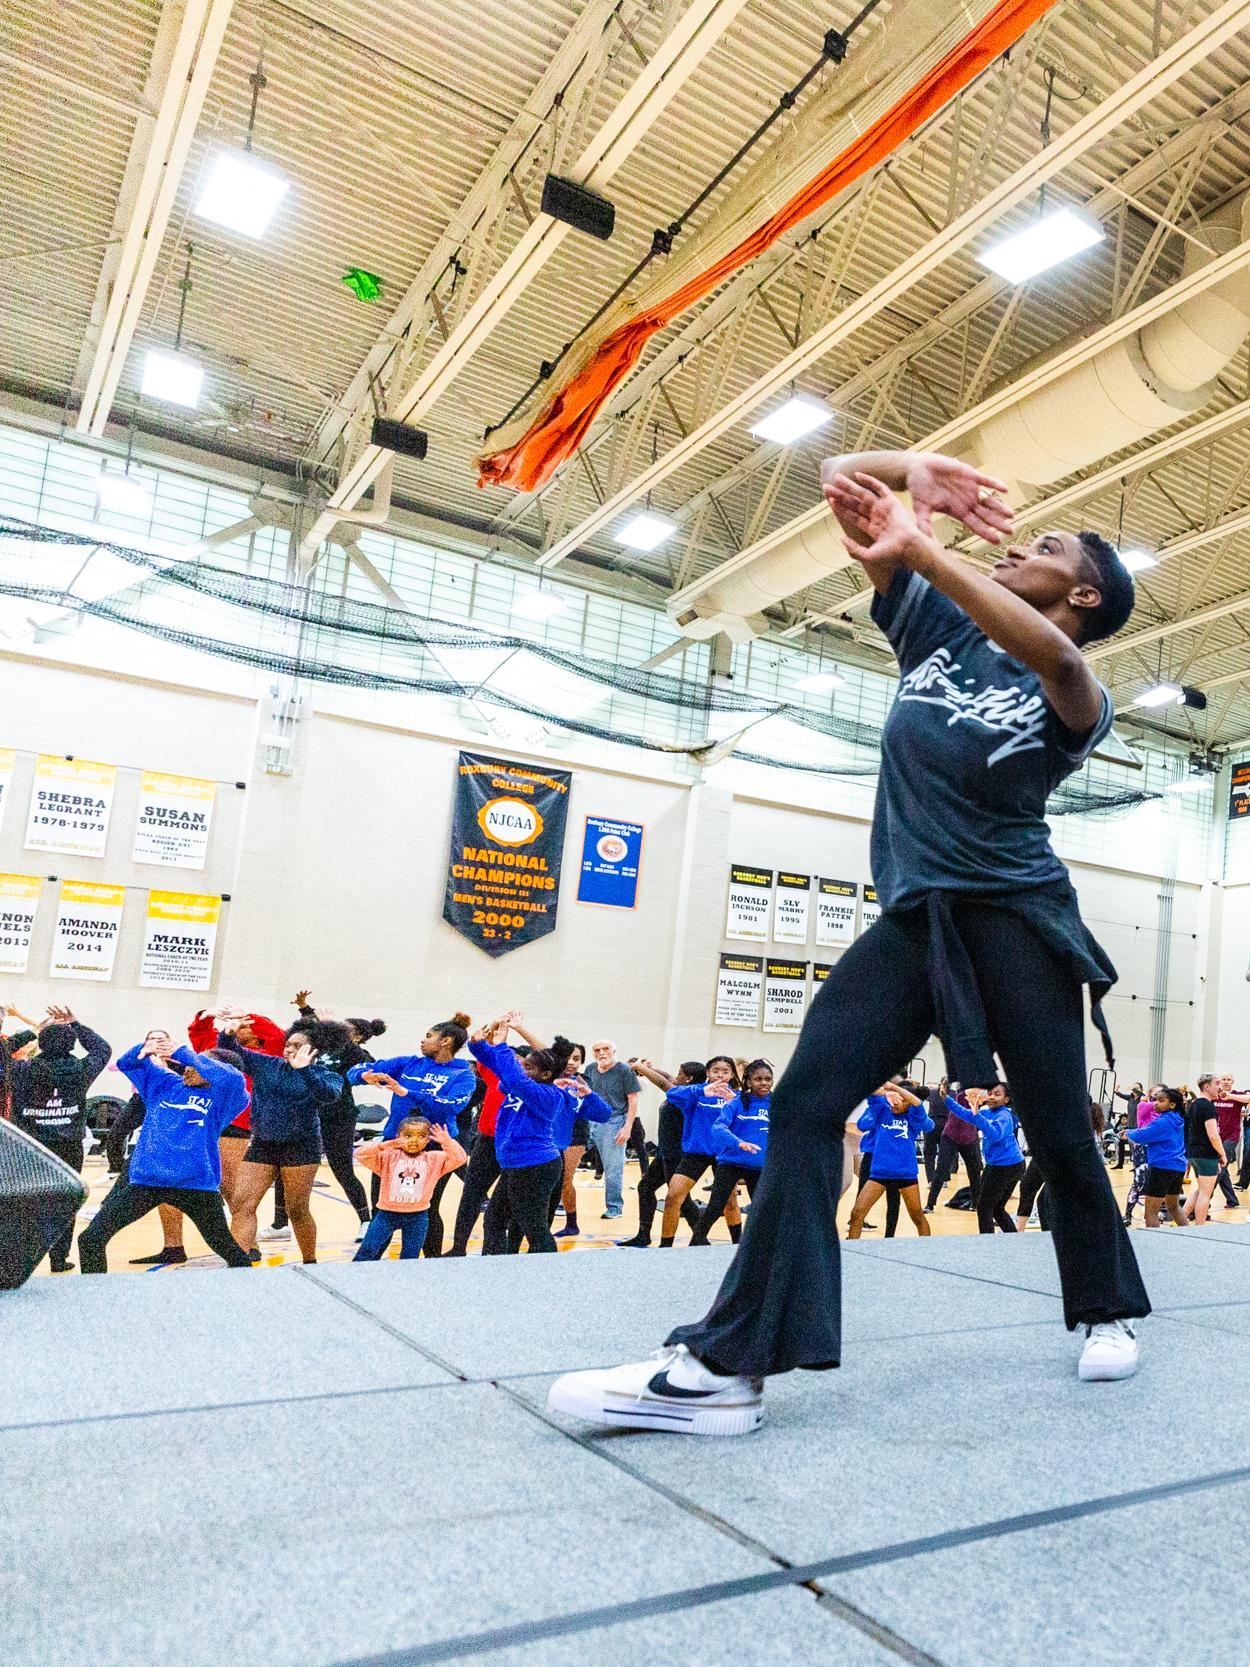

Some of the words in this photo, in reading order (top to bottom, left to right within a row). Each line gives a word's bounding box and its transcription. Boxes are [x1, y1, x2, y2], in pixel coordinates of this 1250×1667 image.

[460, 764, 506, 775] ROXBURY
[508, 767, 568, 794] COMMUNITY
[491, 778, 535, 794] COLLEGE
[38, 791, 106, 808] SHEBRA
[39, 803, 103, 817] LEGRANT
[145, 806, 205, 823] SUSAN
[33, 815, 105, 832] 1978-1979
[140, 816, 207, 832] SUMMONS
[489, 812, 532, 830] NJCAA
[463, 846, 549, 872] NATIONAL
[452, 864, 556, 890] CHAMPIONS
[474, 884, 516, 895] DIVISION
[518, 889, 529, 897] III
[453, 892, 483, 905] MEN'S
[485, 897, 548, 913] BASKETBALL
[731, 894, 768, 906] RONALD
[783, 899, 800, 907] SLY
[732, 903, 766, 912] JACKSON
[819, 904, 855, 914] FRANKIE
[0, 912, 34, 923] NON
[472, 910, 525, 928] 2000
[738, 914, 758, 922] 1981
[780, 916, 800, 924] 1995
[821, 912, 851, 920] PATTEN
[58, 917, 117, 931] AMANDA
[61, 929, 113, 939] HOOVER
[153, 934, 206, 946] MARK
[504, 930, 512, 940] 2
[67, 942, 102, 952] 2014
[147, 943, 210, 955] LESZCZYK
[720, 979, 760, 989] MALCOLM
[726, 989, 752, 997] WYNN
[767, 988, 803, 998] SHAROD
[53, 1088, 58, 1096] I
[46, 1099, 62, 1107] AM
